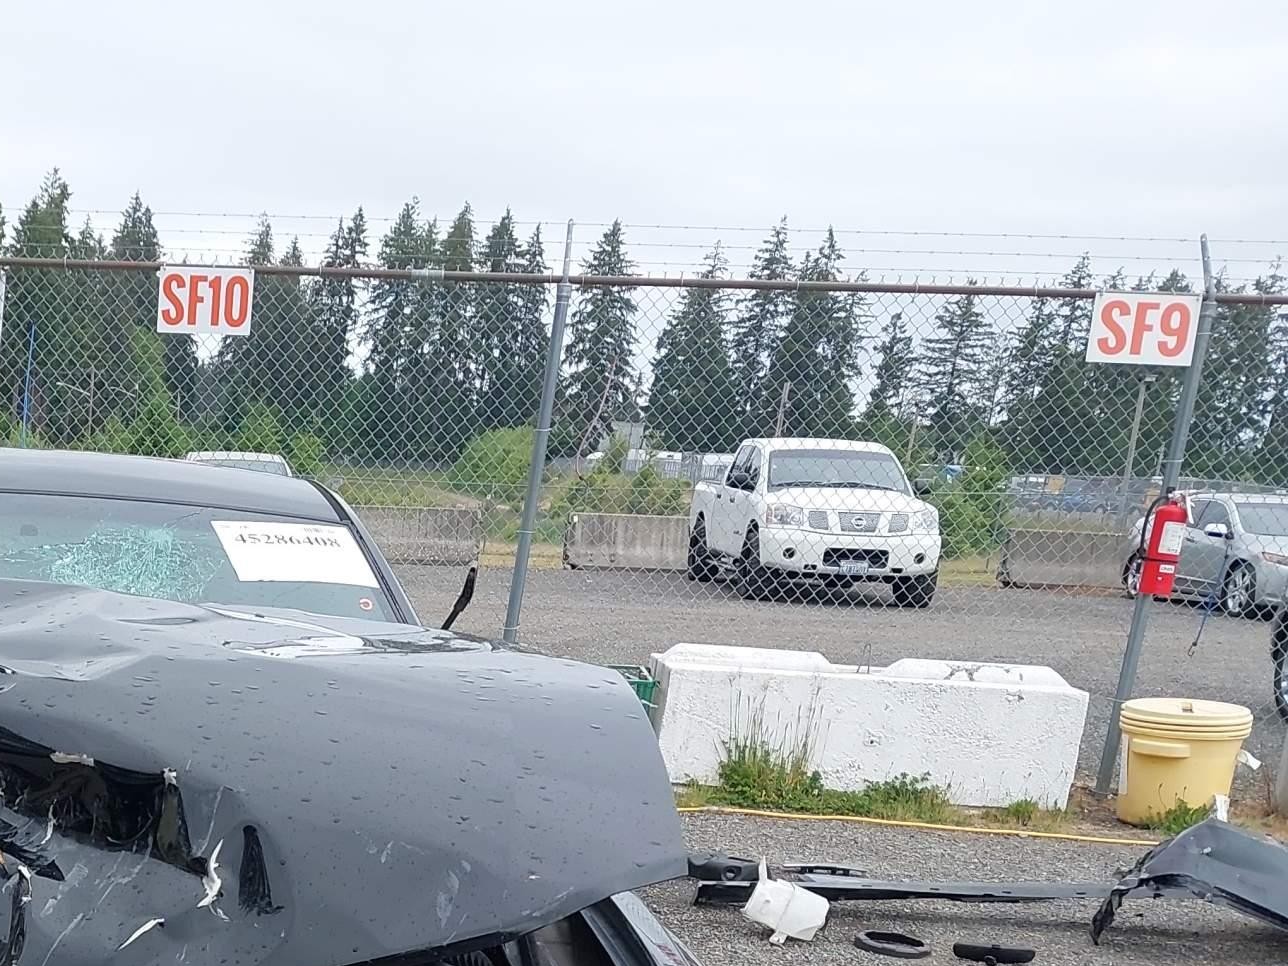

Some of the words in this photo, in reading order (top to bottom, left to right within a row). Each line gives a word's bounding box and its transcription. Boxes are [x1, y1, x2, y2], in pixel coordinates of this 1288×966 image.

[162, 273, 249, 328] SF10
[1097, 300, 1191, 357] SF9
[235, 533, 342, 547] 45286408
